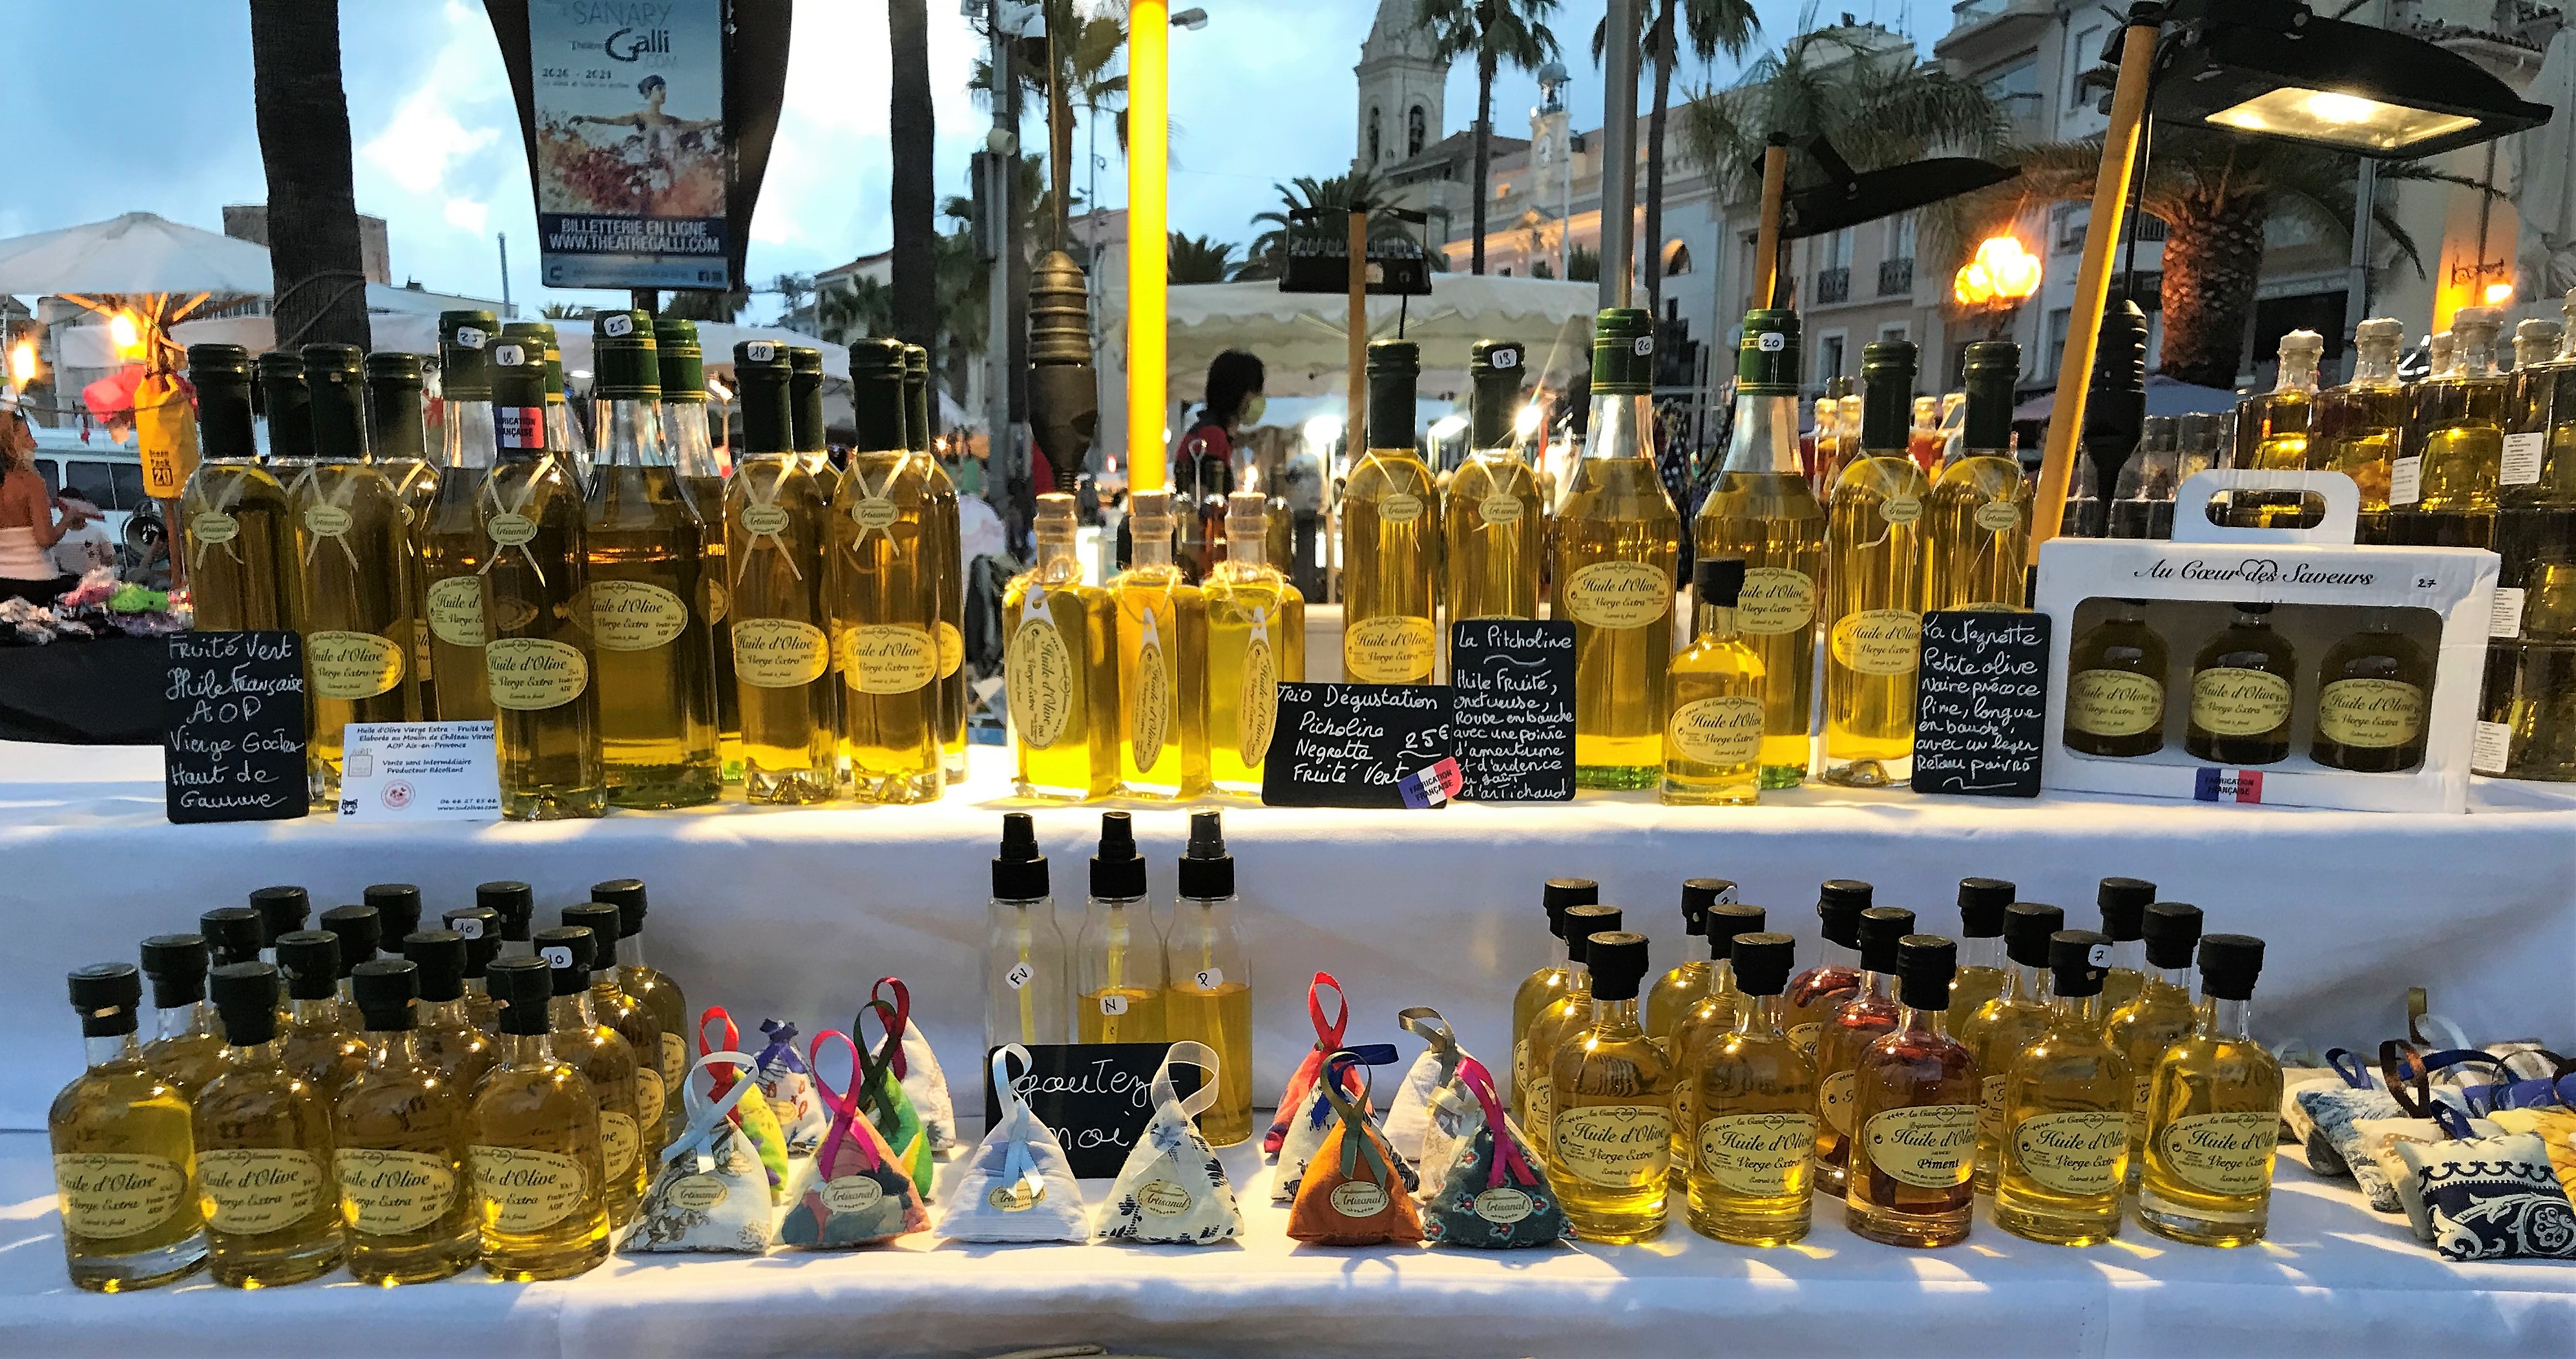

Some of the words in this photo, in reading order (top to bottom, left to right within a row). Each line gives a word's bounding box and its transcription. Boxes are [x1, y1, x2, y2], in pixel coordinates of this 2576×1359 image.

[604, 28, 670, 62] Galli
[561, 218, 644, 235] BILLETTERIE
[646, 220, 665, 235] EN
[667, 221, 708, 236] LIGNE
[1638, 339, 1650, 351] 20
[1763, 338, 1780, 348] 20
[154, 469, 171, 485] 20
[2133, 559, 2173, 579] Au
[2181, 560, 2241, 580] Cœur
[2245, 560, 2279, 585] des
[2282, 563, 2374, 585] Saveurs
[1580, 577, 1617, 593] Huile
[1618, 577, 1659, 592] d'Olive
[1765, 583, 1805, 599] d'Olive
[2418, 578, 2438, 589] 27
[435, 594, 465, 609] Huile
[617, 598, 664, 614] d'Olive
[1595, 596, 1621, 610] Vierge
[1622, 597, 1646, 607] Extra
[1741, 603, 1768, 616] Vierge
[1768, 602, 1793, 614] Extra
[623, 617, 649, 628] Extra
[1355, 632, 1388, 647] Huile
[1458, 625, 1478, 648] La
[1487, 625, 1572, 648] Pitcholine
[1846, 624, 1884, 640] Huile
[169, 633, 244, 659] Fruité
[246, 633, 292, 660] Vert
[768, 636, 813, 651] d'Olive
[879, 643, 922, 658] d'Olive
[1860, 643, 1886, 656] Vierge
[337, 648, 383, 662] d'Olive
[1924, 647, 1980, 675] Petite
[1982, 650, 2038, 675] olive
[488, 656, 516, 672] Huile
[520, 655, 567, 671] d'Olive
[165, 667, 227, 700] Huile
[498, 676, 525, 690] Vierge
[527, 676, 553, 687] Extra
[1458, 669, 1491, 690] Huile
[1324, 685, 1438, 713] Dégustation
[2106, 687, 2150, 701] d'Olive
[2198, 683, 2229, 698] Huile
[2231, 685, 2276, 700] d'Olive
[2330, 694, 2365, 710] Huile
[1974, 695, 2042, 727] longue
[1299, 711, 1384, 738] Picholine
[1688, 712, 1727, 729] Huile
[1729, 712, 1762, 729] d'Olive
[1919, 720, 1943, 732] en
[1454, 729, 1488, 739] avec
[1491, 729, 1518, 740] une
[1703, 732, 1732, 747] Vierge
[1733, 732, 1754, 744] Extra
[170, 725, 236, 762] Vierge
[1916, 738, 1963, 752] avec
[171, 760, 230, 787] Haut
[236, 760, 280, 783] de
[1409, 769, 1452, 794] FABRICATION
[2204, 777, 2254, 786] FABRICATION
[1415, 780, 1454, 802] FRANÇAISE
[2207, 786, 2250, 796] FRANÇAISE
[180, 790, 288, 809] Gamme
[549, 953, 565, 965] 10
[1010, 968, 1030, 984] FV
[1198, 972, 1209, 986] P
[1104, 999, 1117, 1012] N
[1571, 1122, 1617, 1143] Huile
[1620, 1124, 1666, 1143] d'Olive
[1890, 1129, 1938, 1148] Huile
[2037, 1130, 2085, 1150] Huile
[2188, 1130, 2238, 1150] Huile
[1718, 1131, 1764, 1151] Huile
[1768, 1132, 1813, 1151] d'Olive
[1589, 1148, 1624, 1164] Vierge
[1626, 1148, 1654, 1161] Extra
[1737, 1156, 1772, 1172] Vierge
[1774, 1157, 1801, 1169] Extra
[1917, 1157, 1960, 1170] Piment
[2056, 1154, 2090, 1172] Vierge
[2208, 1154, 2244, 1172] Vierge
[92, 1173, 157, 1193] d'Olive
[238, 1168, 300, 1189] d'Olive
[370, 1169, 430, 1189] d'Olive
[499, 1167, 558, 1187] d'Olive
[379, 1195, 412, 1207] Extra
[829, 1188, 874, 1200] Artisanal
[1146, 1194, 1188, 1208] Artisanal
[1340, 1194, 1383, 1206] Artisanal
[1485, 1200, 1527, 1212] Artisanal
